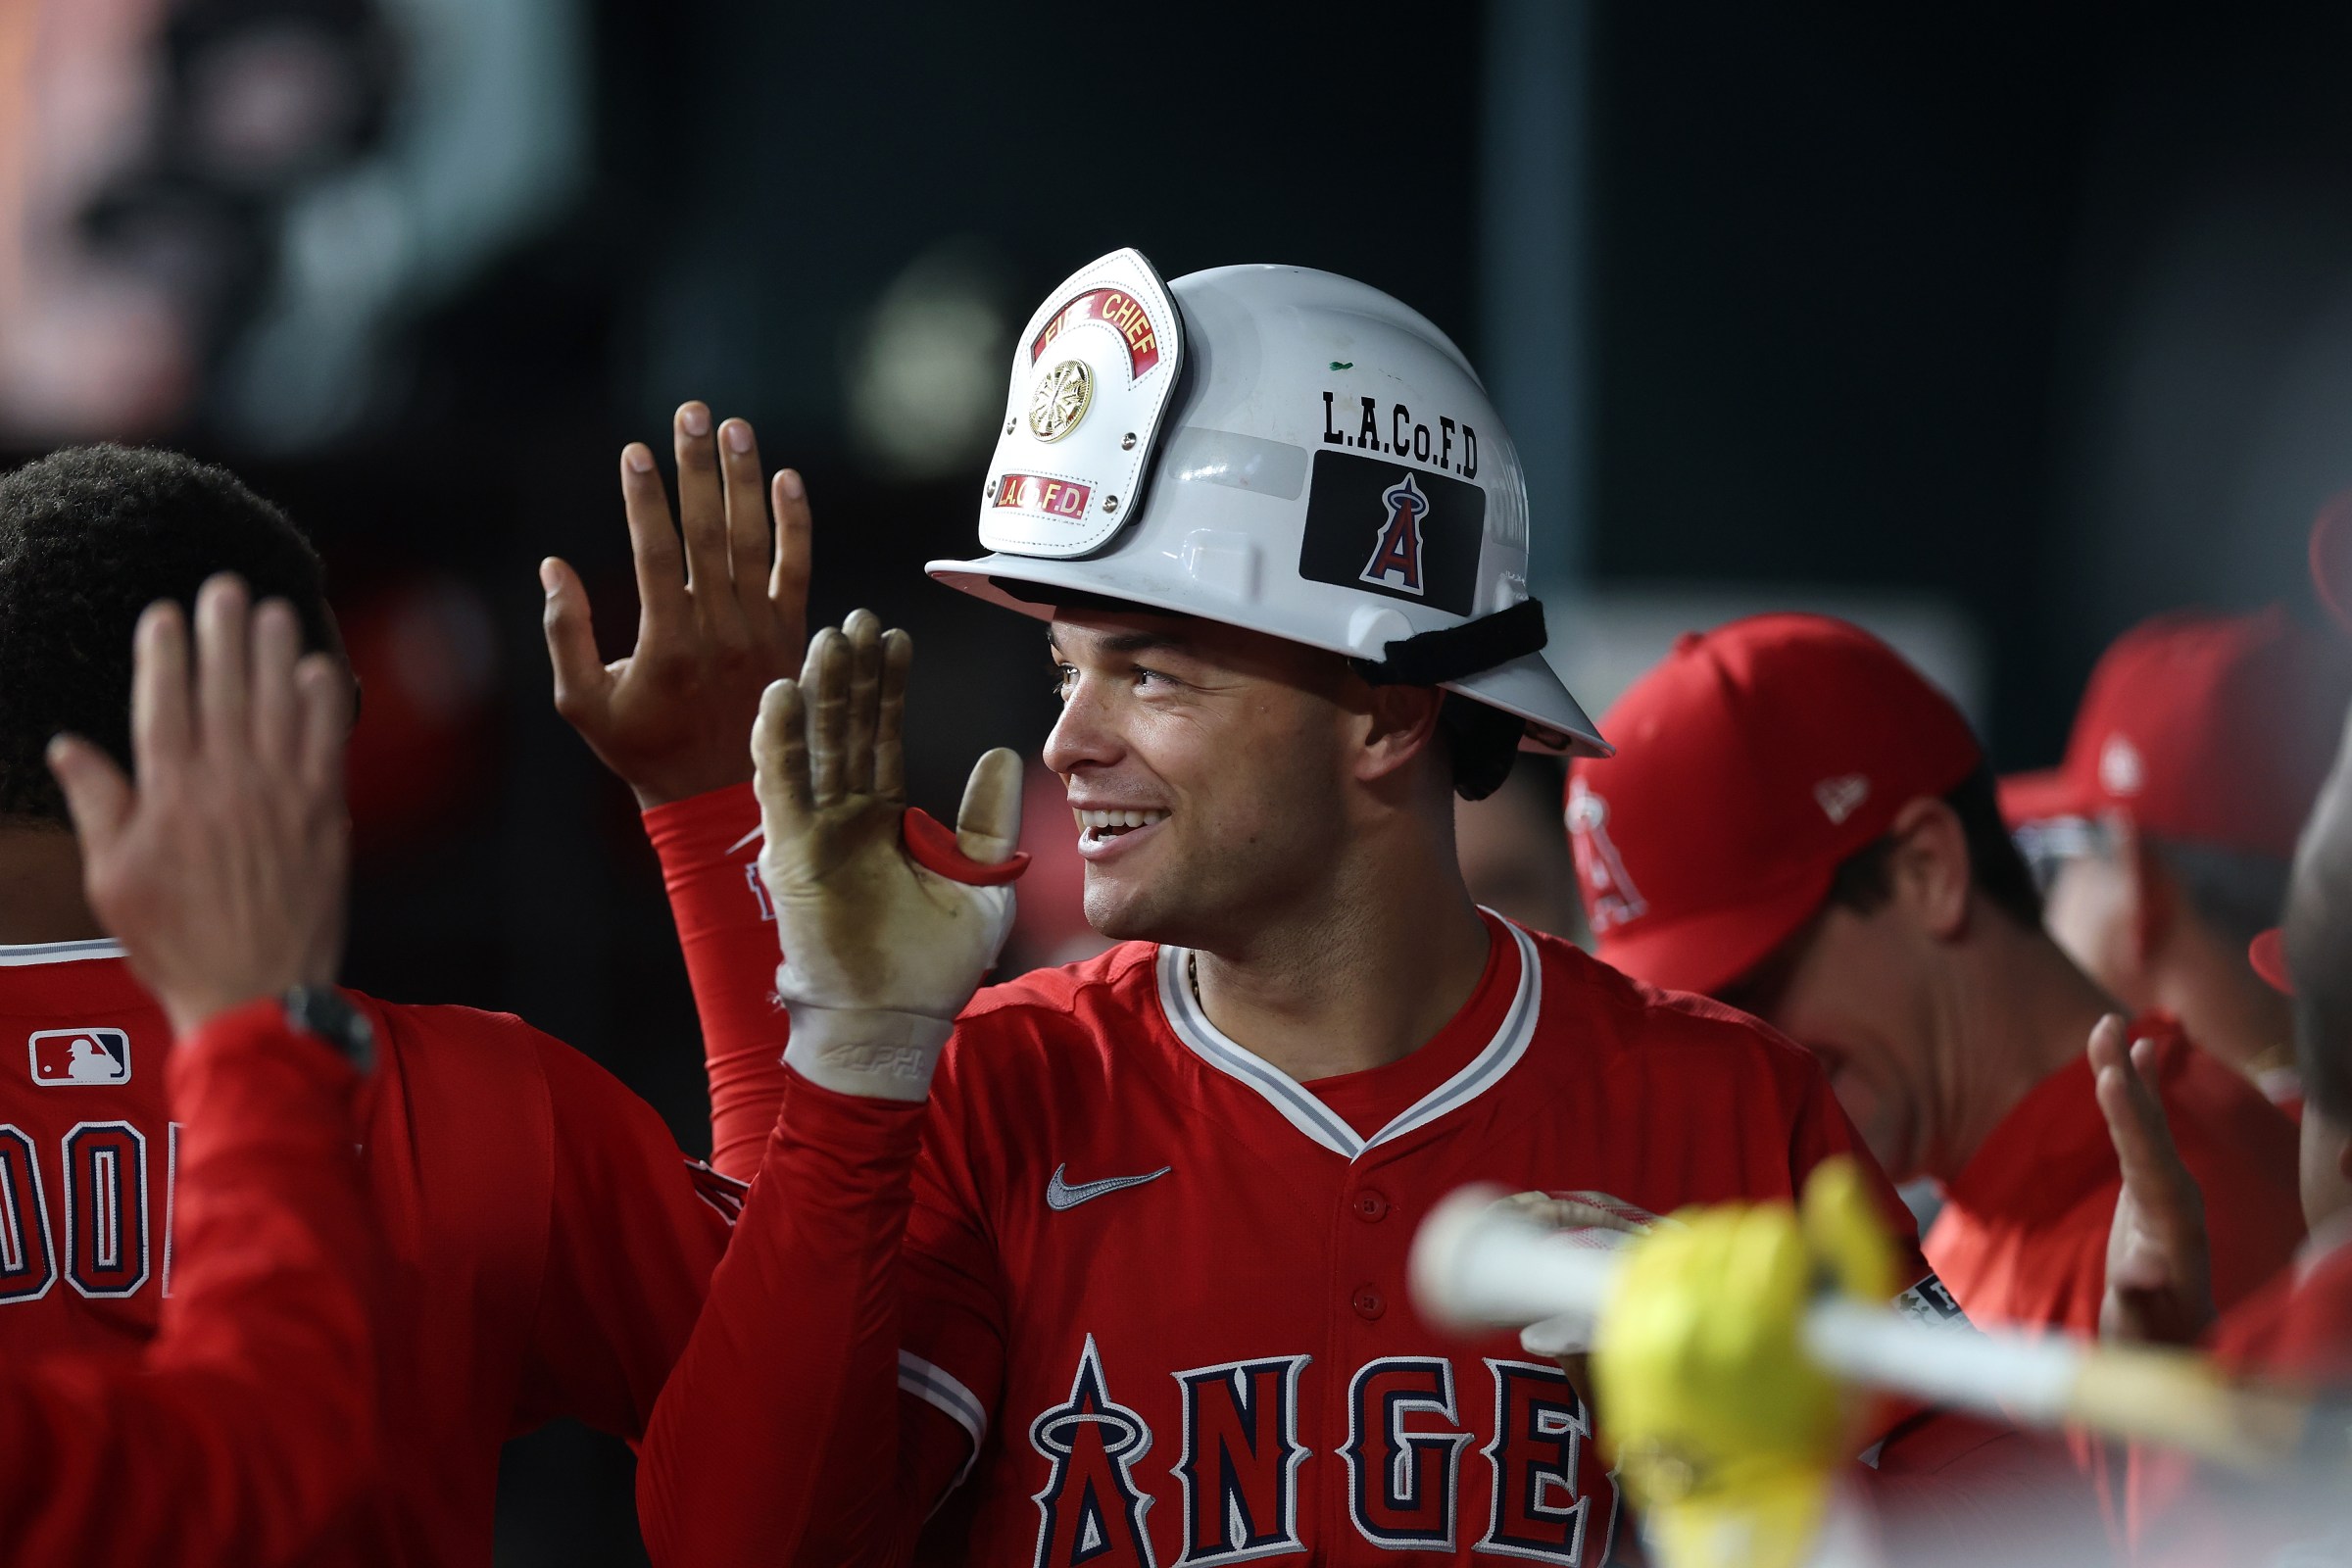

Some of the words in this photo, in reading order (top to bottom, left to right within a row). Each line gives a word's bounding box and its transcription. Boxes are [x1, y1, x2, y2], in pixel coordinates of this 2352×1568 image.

[1102, 293, 1156, 354] CHIEF
[1359, 471, 1430, 596] A
[1029, 1332, 1623, 1568] ANGE
